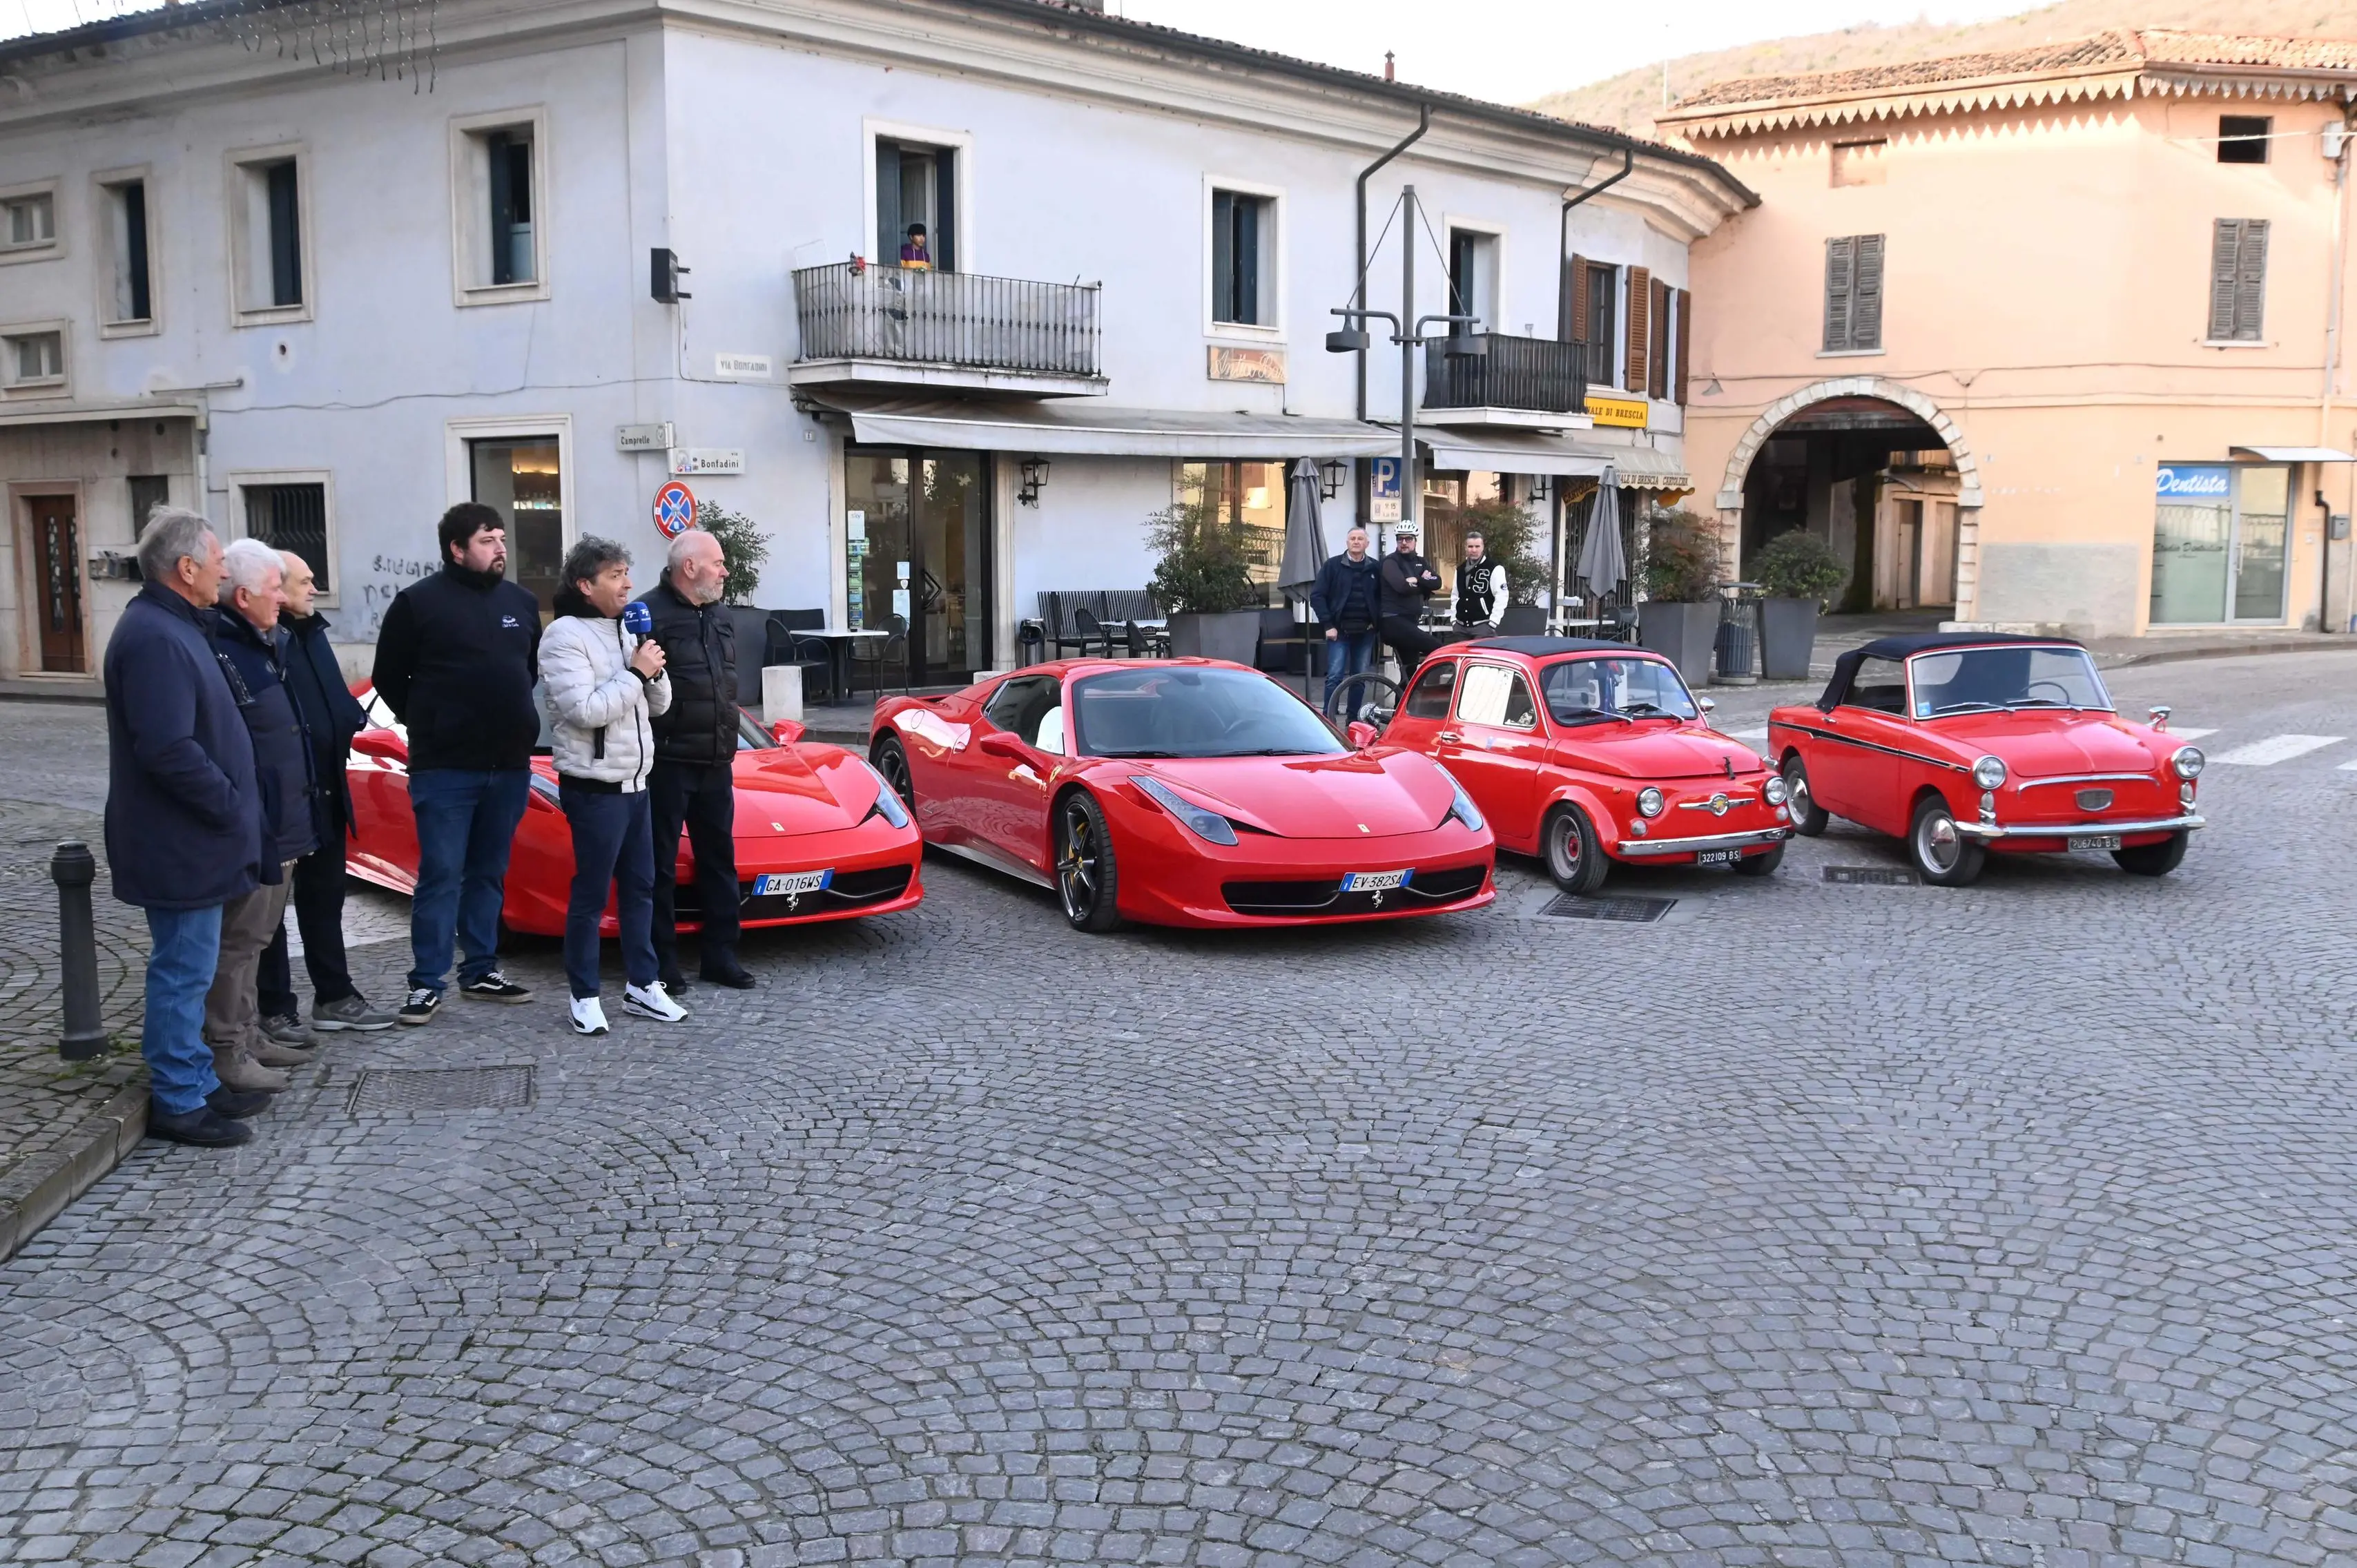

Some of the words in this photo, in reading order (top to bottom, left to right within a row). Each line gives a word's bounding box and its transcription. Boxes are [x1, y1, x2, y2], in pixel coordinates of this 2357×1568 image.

[720, 360, 732, 370] VIA
[1605, 407, 1613, 416] DI
[1615, 408, 1643, 420] BRESCIA
[621, 434, 650, 446] Camprelle
[701, 458, 739, 469] Bonfadini
[1377, 459, 1395, 492] P
[1637, 474, 1659, 485] BRESCIA
[2157, 468, 2228, 493] Dentista
[1472, 568, 1491, 594] S
[1702, 851, 1726, 862] 322109
